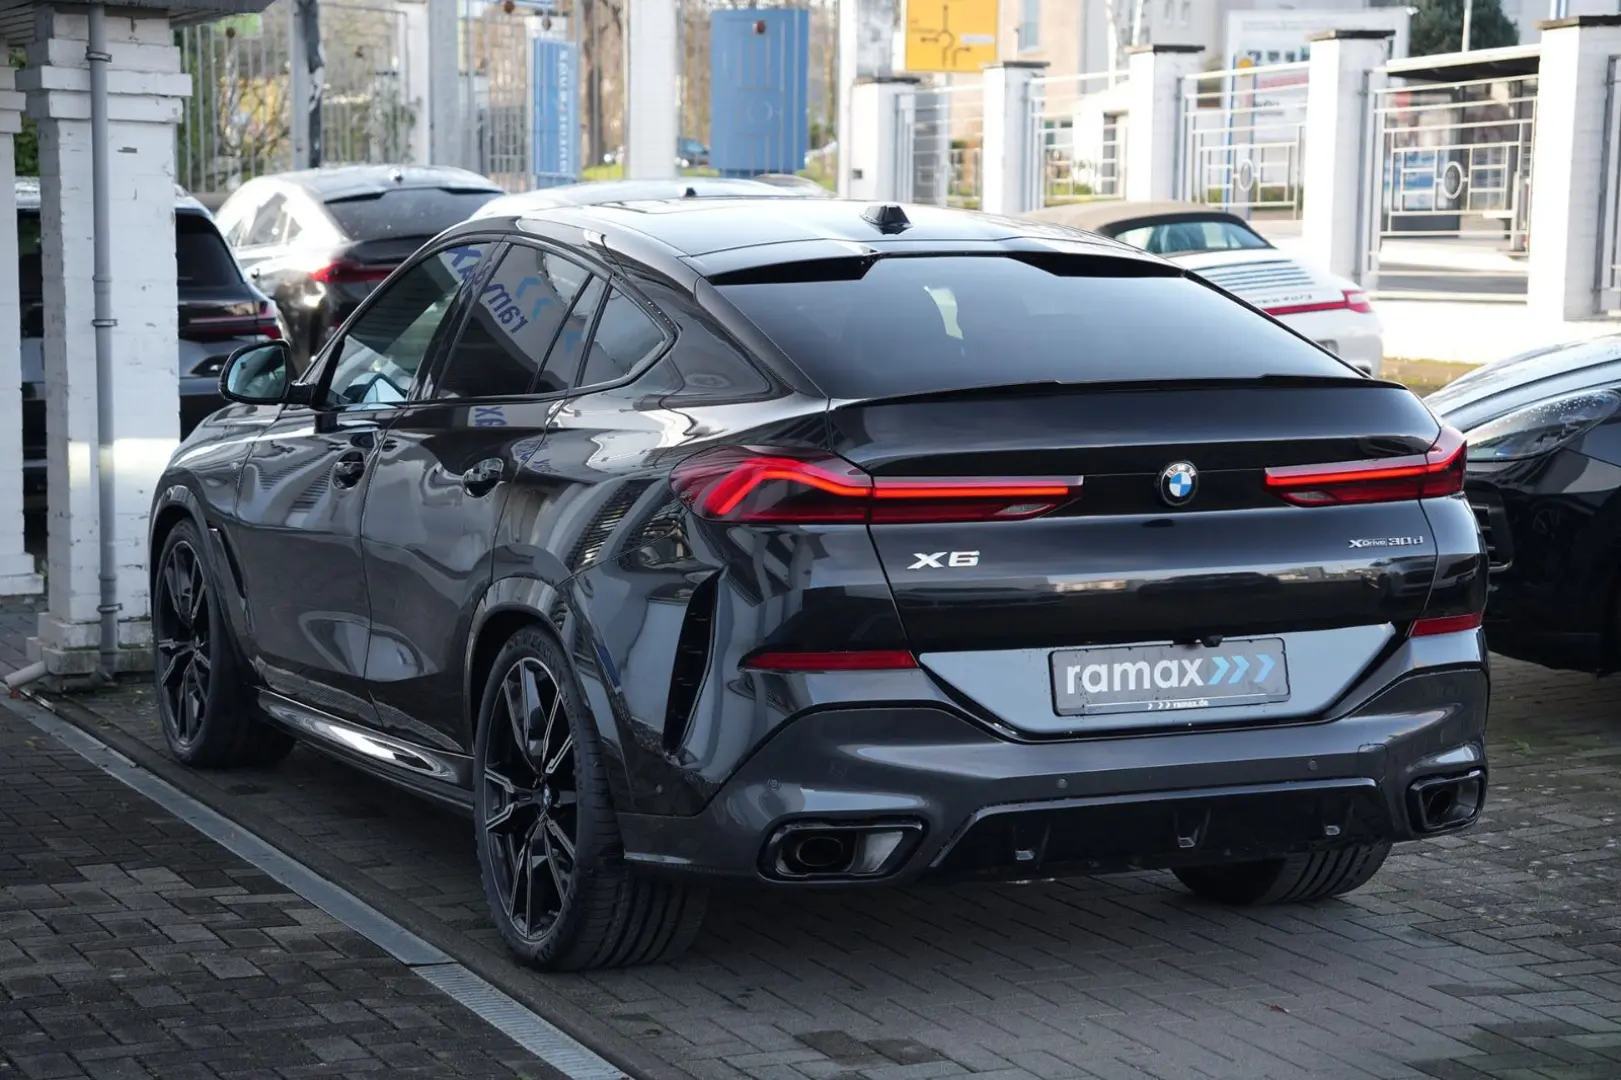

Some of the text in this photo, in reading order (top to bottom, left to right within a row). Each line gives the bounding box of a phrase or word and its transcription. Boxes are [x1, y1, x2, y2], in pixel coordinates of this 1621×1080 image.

[1388, 535, 1424, 546] 30d
[906, 549, 980, 570] X6
[1066, 658, 1204, 694] ramax
